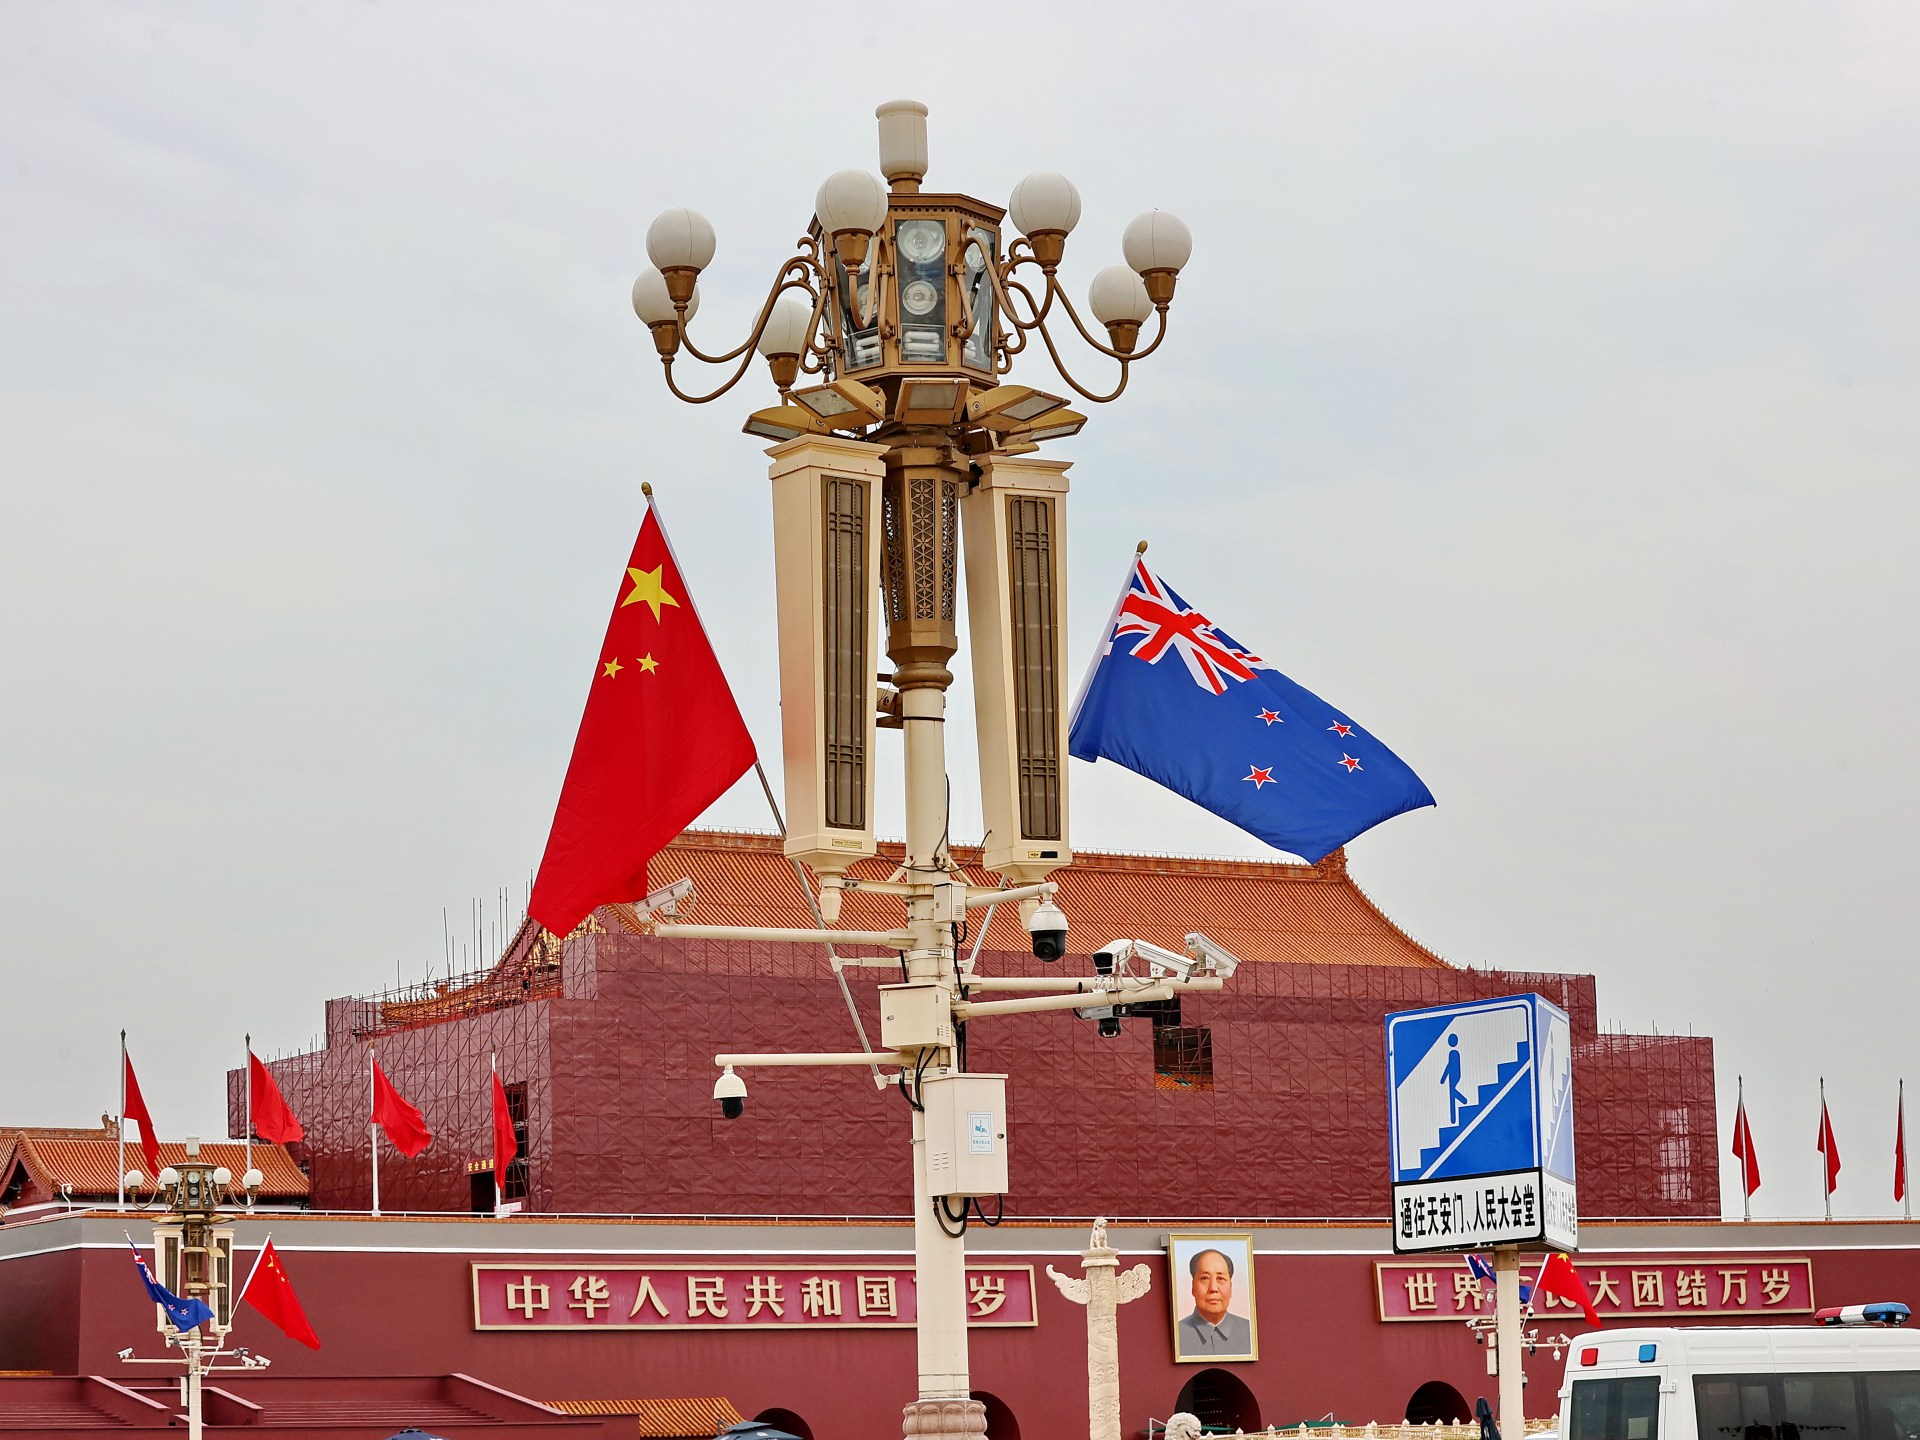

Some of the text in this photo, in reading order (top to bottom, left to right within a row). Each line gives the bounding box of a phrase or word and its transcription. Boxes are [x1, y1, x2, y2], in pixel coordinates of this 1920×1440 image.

[1400, 1184, 1536, 1239] 通往天安门、人民大会堂
[506, 1275, 1006, 1318] 中华人民共和国岁
[1404, 1269, 1791, 1311] 世界大团结万岁
